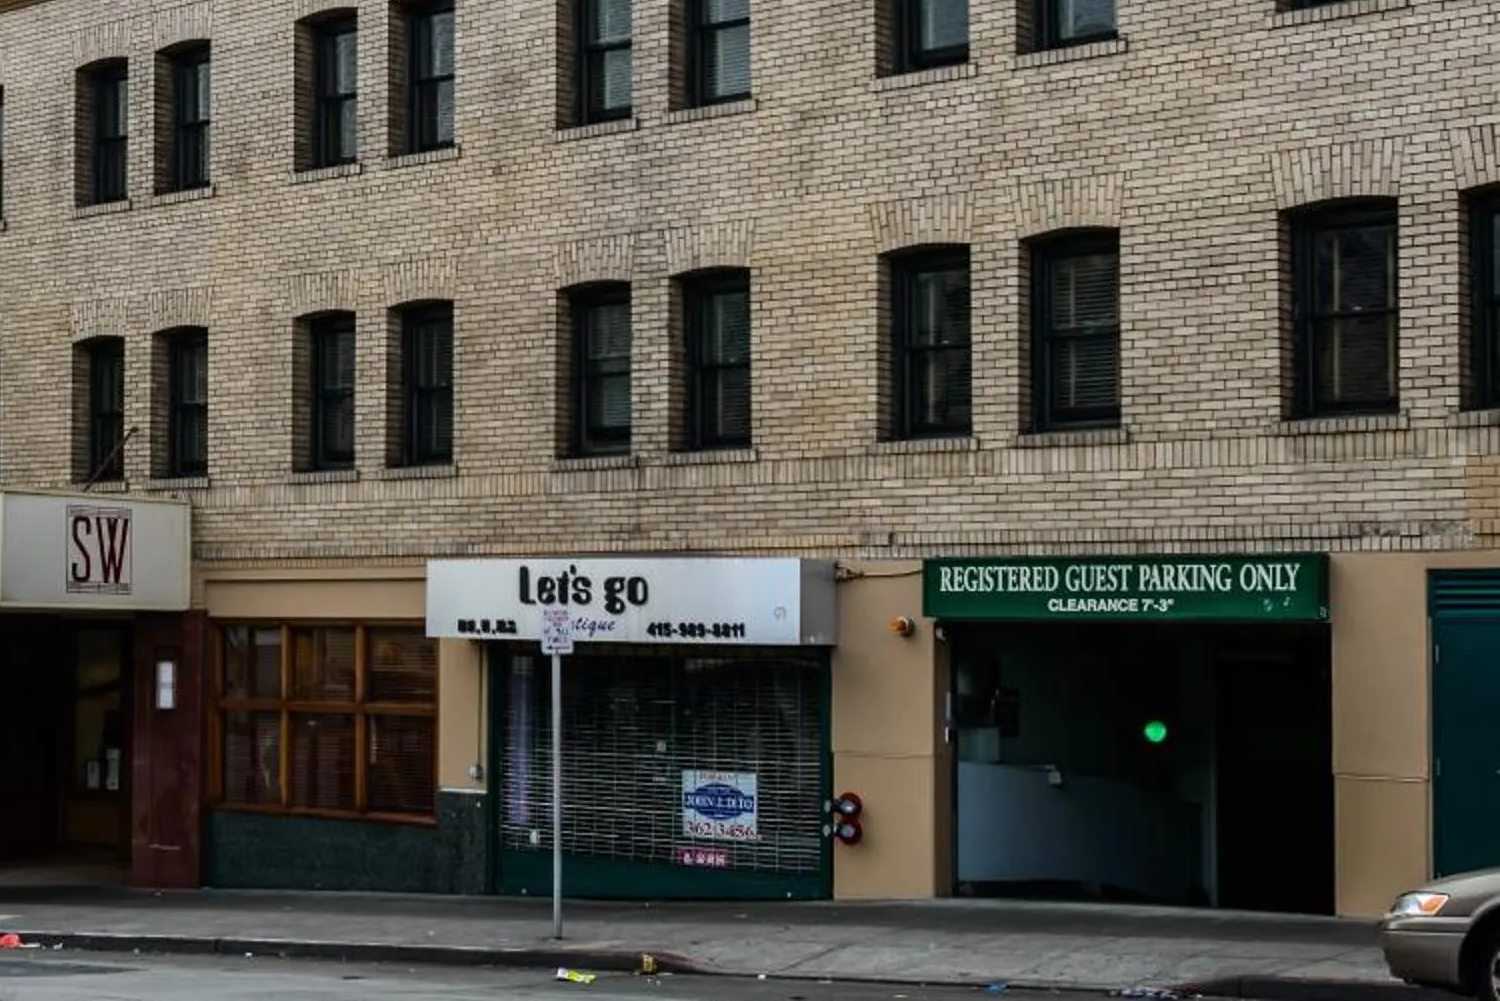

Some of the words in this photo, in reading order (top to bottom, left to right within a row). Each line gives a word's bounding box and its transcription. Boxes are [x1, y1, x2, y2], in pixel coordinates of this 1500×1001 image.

[71, 516, 129, 584] SW
[519, 564, 592, 606] Let's
[604, 575, 649, 614] go
[939, 566, 1059, 592] REGISTERED
[1065, 565, 1132, 592] GUEST
[1138, 564, 1232, 592] PARKING
[1239, 563, 1300, 591] ONLY
[1048, 598, 1138, 613] CLEARANCE
